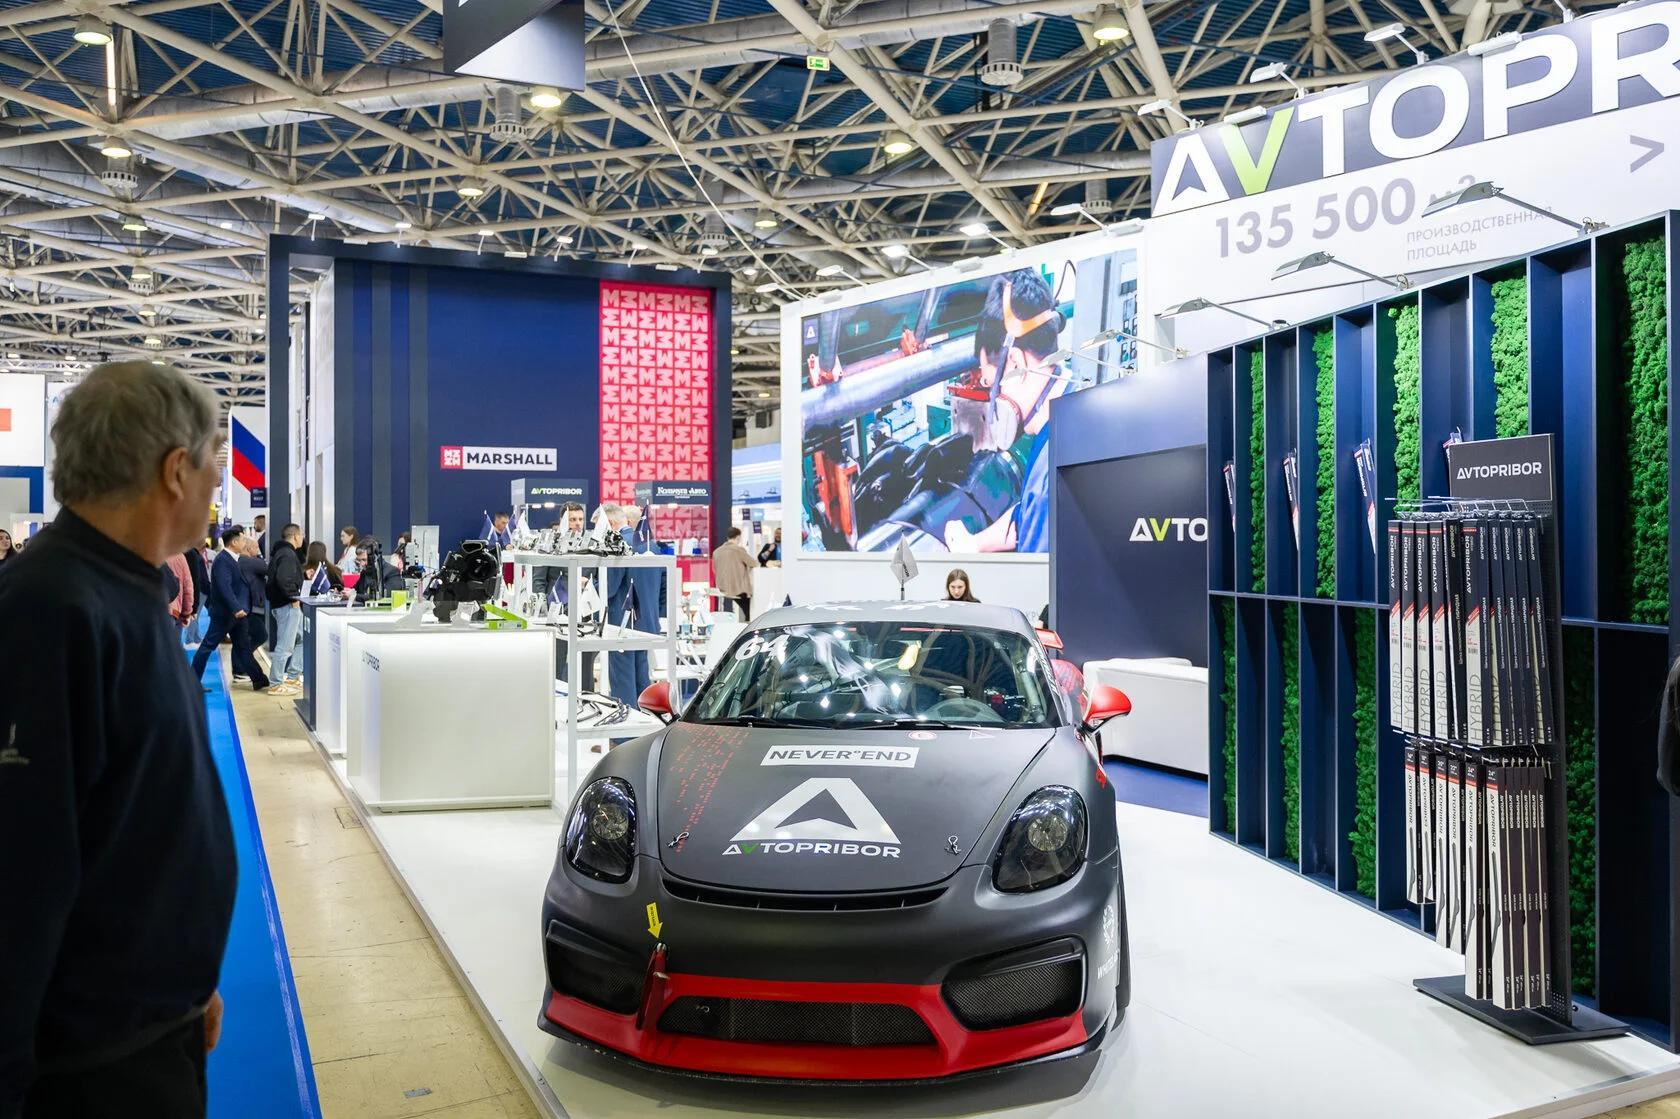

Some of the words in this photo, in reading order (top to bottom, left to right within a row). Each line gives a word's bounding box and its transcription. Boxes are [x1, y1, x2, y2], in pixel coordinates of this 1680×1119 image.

[1154, 0, 1680, 217] AVTOPR
[1215, 205, 1293, 258] 135
[1314, 177, 1417, 240] 500
[1407, 239, 1477, 262] ПЛОЩАДЬ
[467, 452, 552, 465] MARSHALL
[1456, 462, 1543, 480] AVTOPRIBOR
[1128, 516, 1208, 542] AVTO
[1393, 662, 1401, 724] HYBRID
[1404, 666, 1414, 729] HYBRID
[1420, 668, 1430, 732] HYBRID
[1437, 671, 1447, 734] HYBRID
[1470, 674, 1482, 740] HYBRID
[722, 840, 902, 859] AVTOPRIBOR
